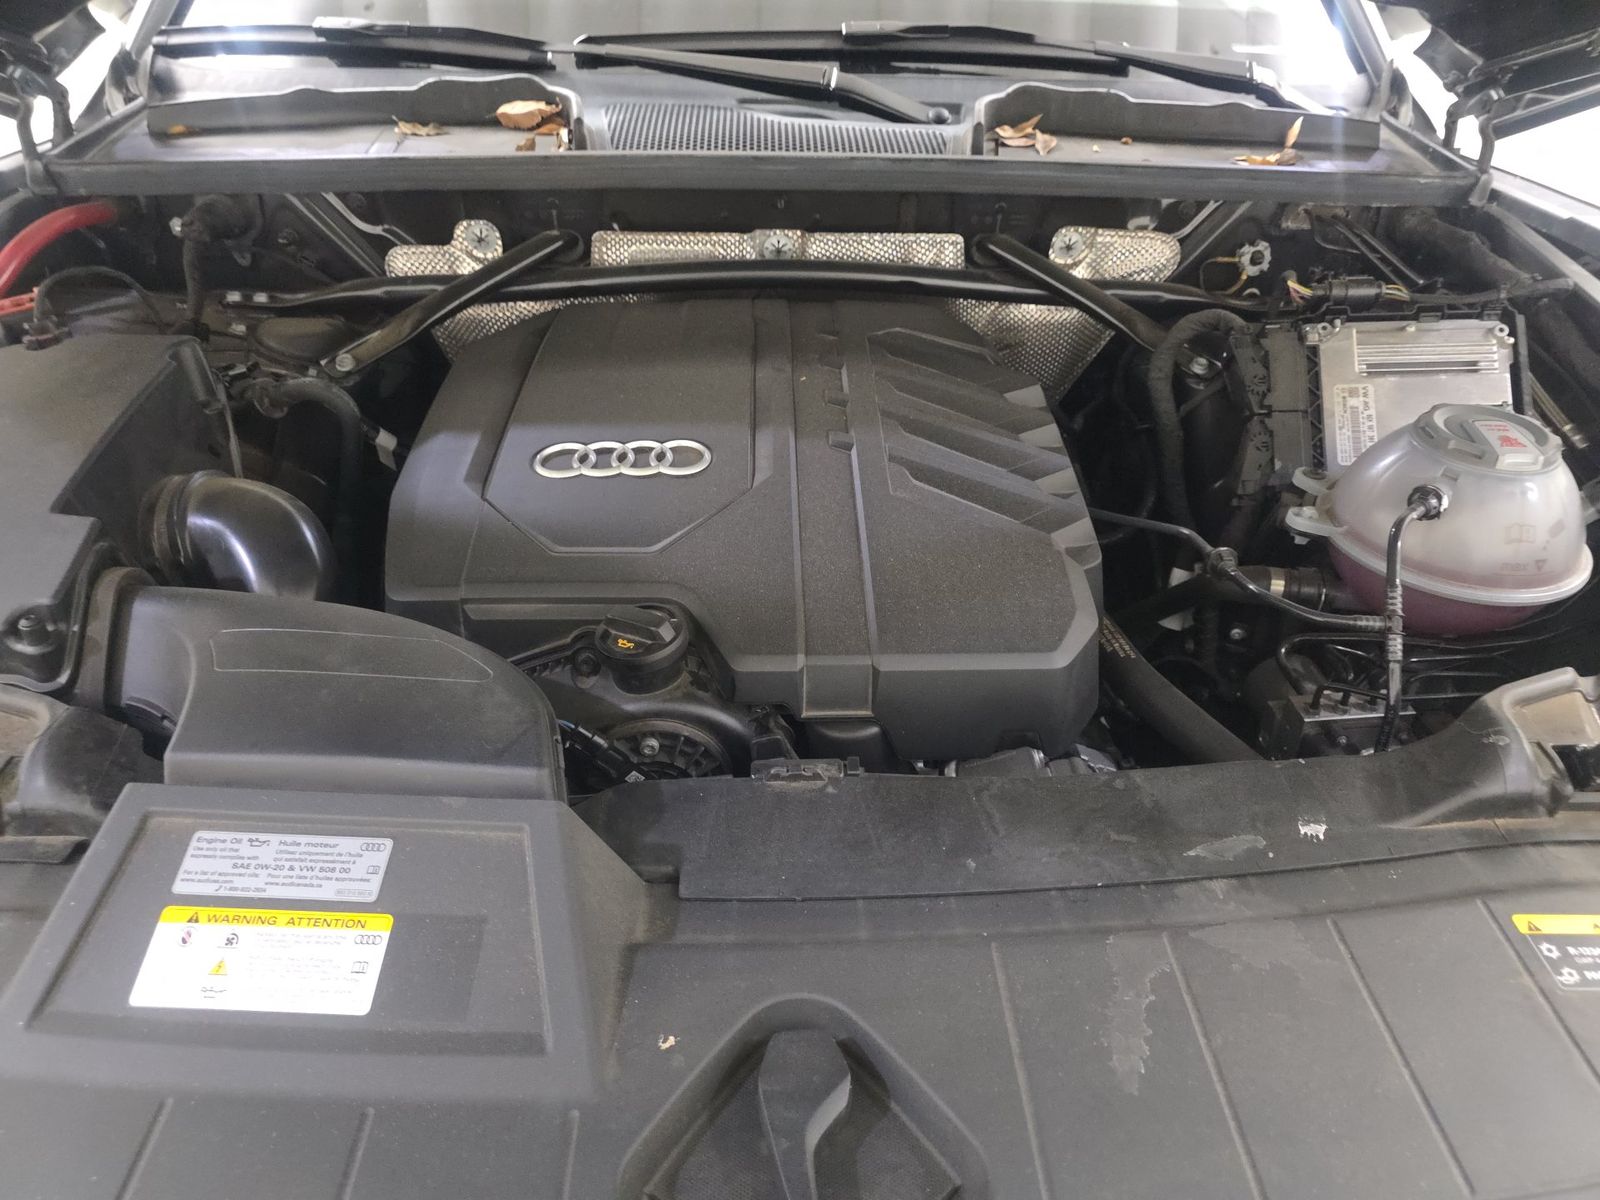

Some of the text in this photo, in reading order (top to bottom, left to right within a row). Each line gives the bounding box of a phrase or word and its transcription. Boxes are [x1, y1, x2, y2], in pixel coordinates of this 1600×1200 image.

[196, 836, 228, 844] Engine
[278, 840, 302, 848] Huile
[206, 914, 367, 929] WARNING ATTENTION
